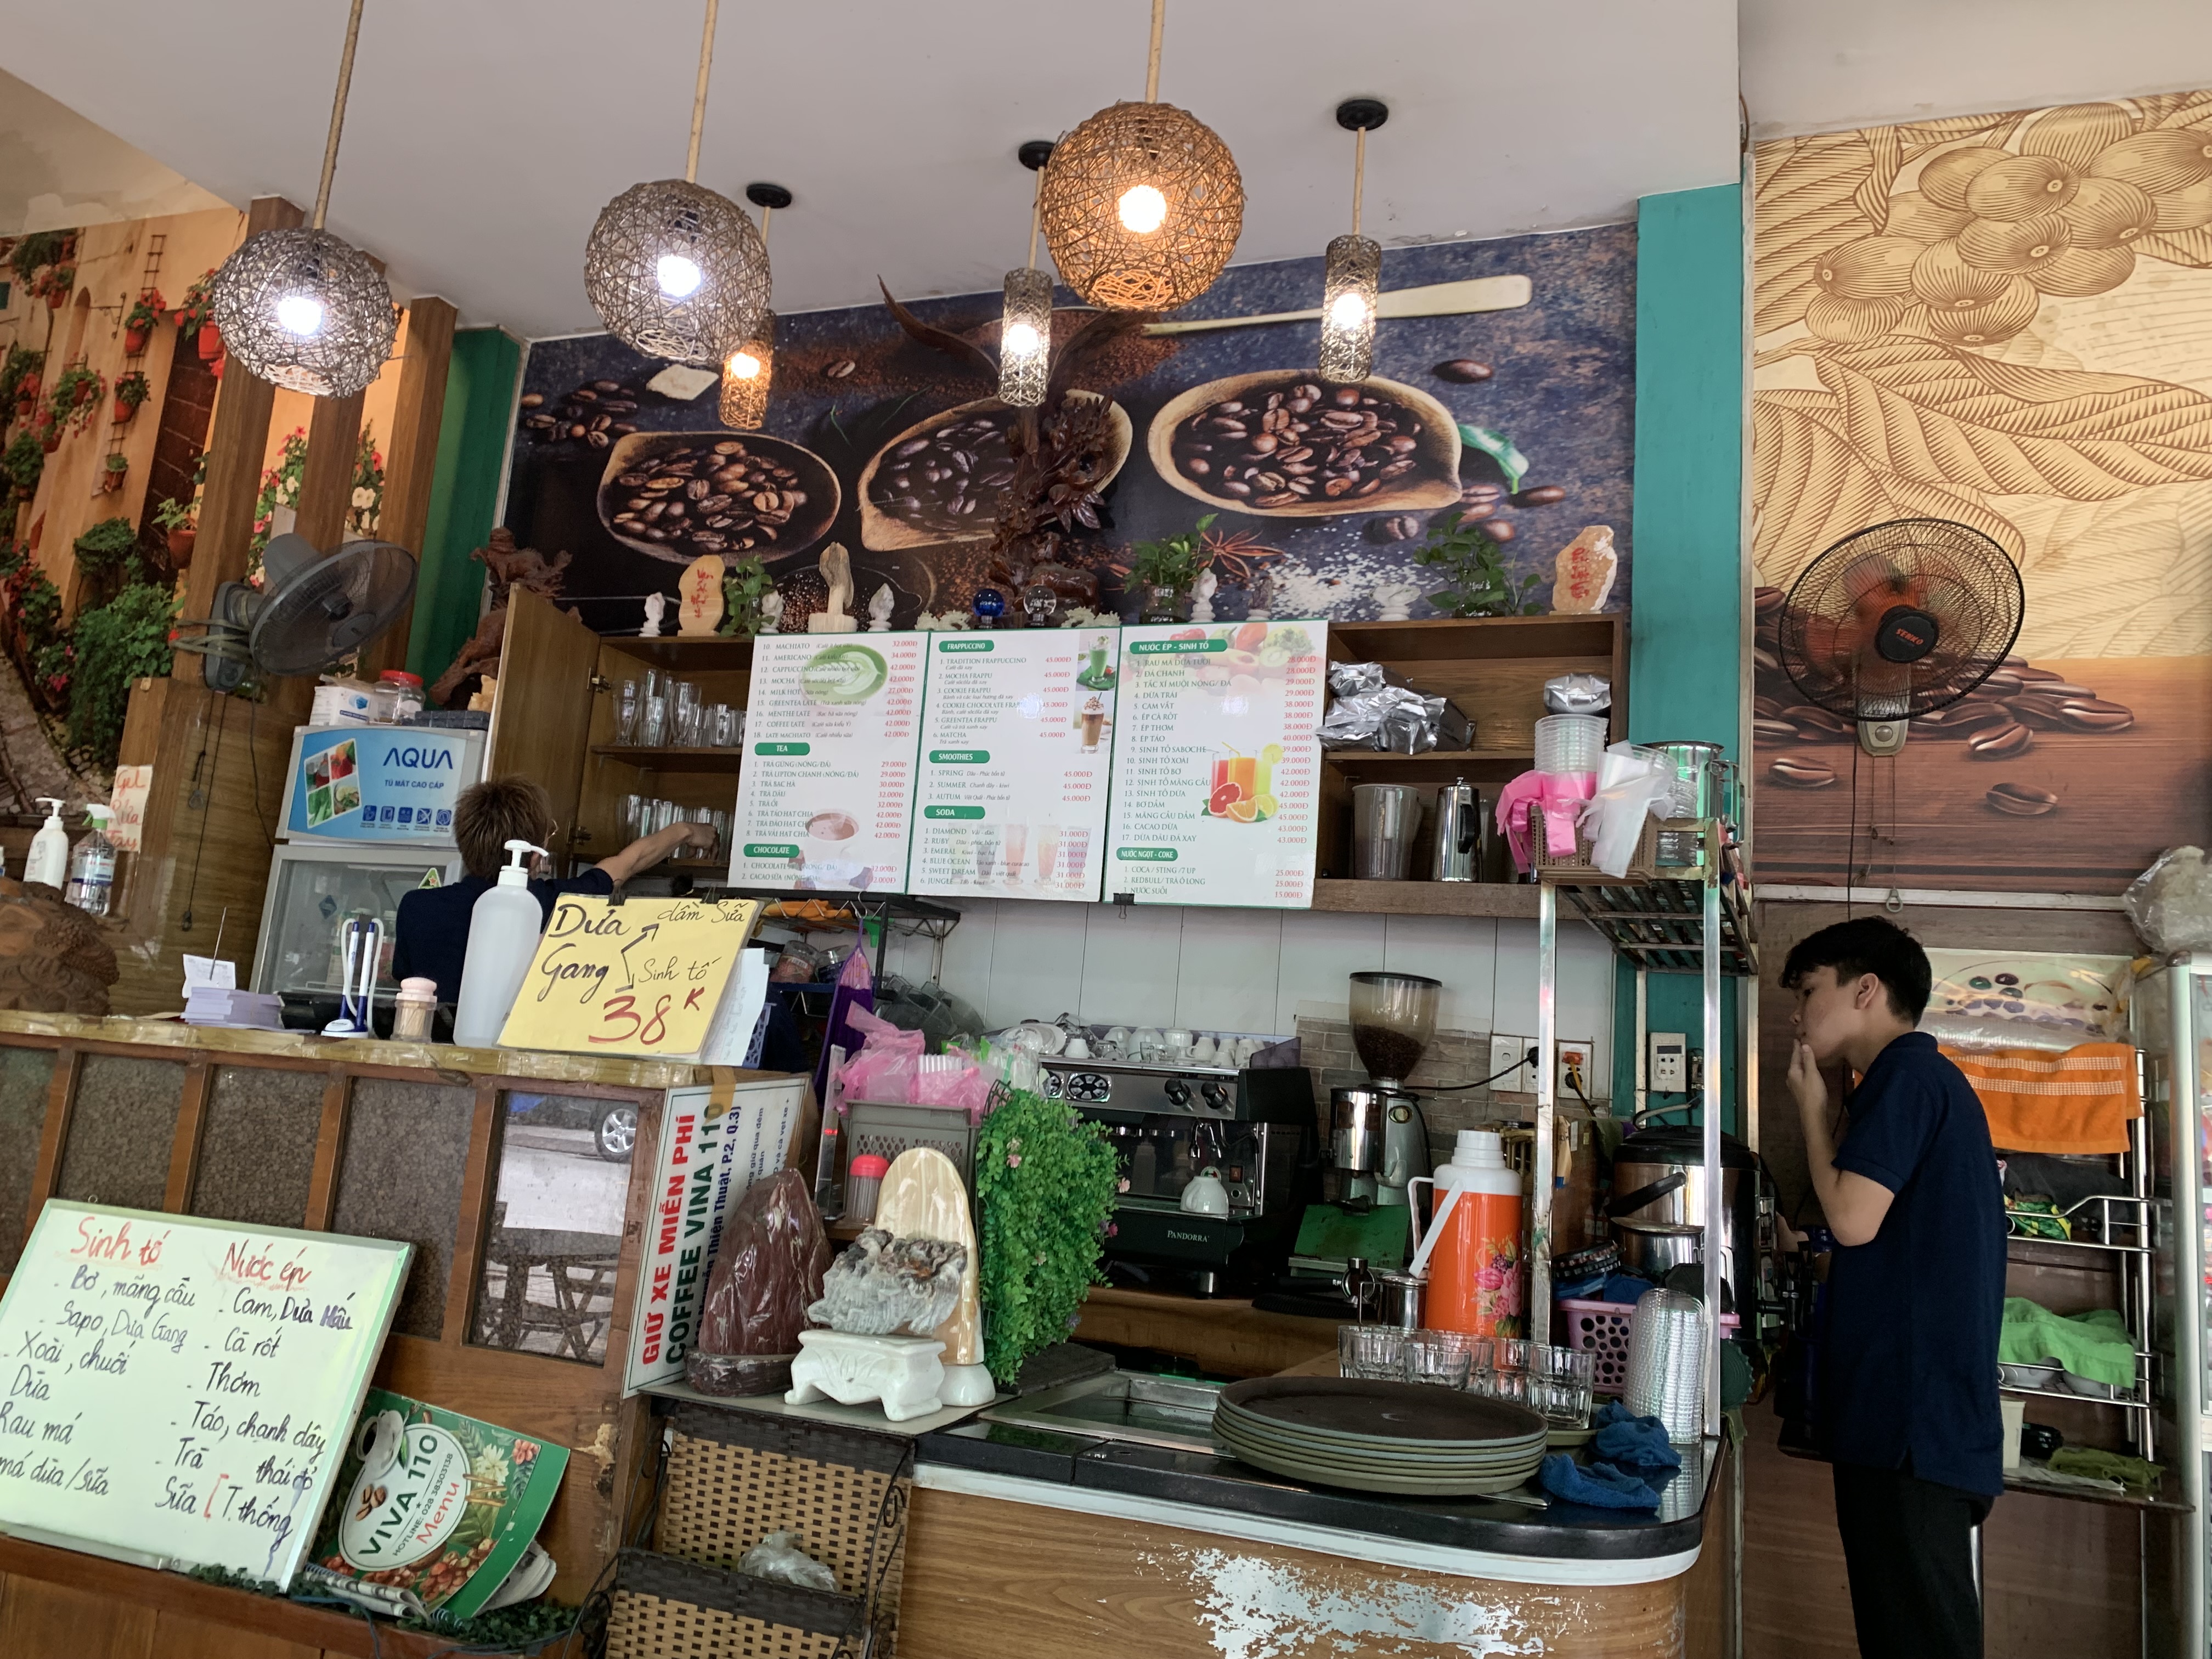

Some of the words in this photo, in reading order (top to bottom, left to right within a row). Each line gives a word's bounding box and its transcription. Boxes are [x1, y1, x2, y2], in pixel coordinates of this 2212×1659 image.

[1139, 643, 1160, 651] NƯỚC
[1162, 642, 1172, 651] ÉP
[1199, 640, 1210, 650] TỐ
[1896, 628, 1924, 645] SENKO
[382, 748, 453, 770] AQUA
[117, 769, 145, 797] Gel
[753, 846, 790, 854] CHOCOLATE
[1121, 848, 1137, 857] NƯỚC
[1138, 851, 1154, 859] NGỌT
[537, 943, 610, 1004] Gang
[638, 956, 680, 983] Sinh
[688, 956, 722, 981] tố
[588, 994, 672, 1045] 38
[672, 1114, 695, 1165] PHÍ
[707, 1215, 724, 1257] Thiện
[726, 1105, 742, 1135] Q.3)
[658, 1174, 686, 1255] MIỄN
[1167, 1229, 1207, 1243] PANDORRA
[70, 1216, 132, 1261] Sinh
[139, 1229, 172, 1266] tố
[220, 1239, 274, 1282] Nước
[279, 1246, 313, 1293] ép
[651, 1263, 672, 1305] XE
[665, 1245, 702, 1364] COFFEE
[684, 1163, 714, 1239] VINA
[112, 1274, 162, 1320] mãng
[151, 1312, 189, 1353] Gang
[251, 1326, 284, 1358] rốt
[642, 1312, 664, 1365] GIỮ
[80, 1338, 136, 1375] chuối
[206, 1361, 261, 1397] Thơm
[0, 1401, 36, 1438] Rau
[42, 1411, 83, 1445] má
[236, 1410, 291, 1443] chanh
[292, 1420, 327, 1465] dây
[255, 1454, 295, 1486] thái
[154, 1475, 197, 1515] Sữa
[358, 1489, 418, 1556] VIVA
[407, 1434, 438, 1480] 110
[415, 1482, 460, 1545] Menu
[392, 1516, 425, 1557] HOTLINE:
[421, 1498, 435, 1516] 028
